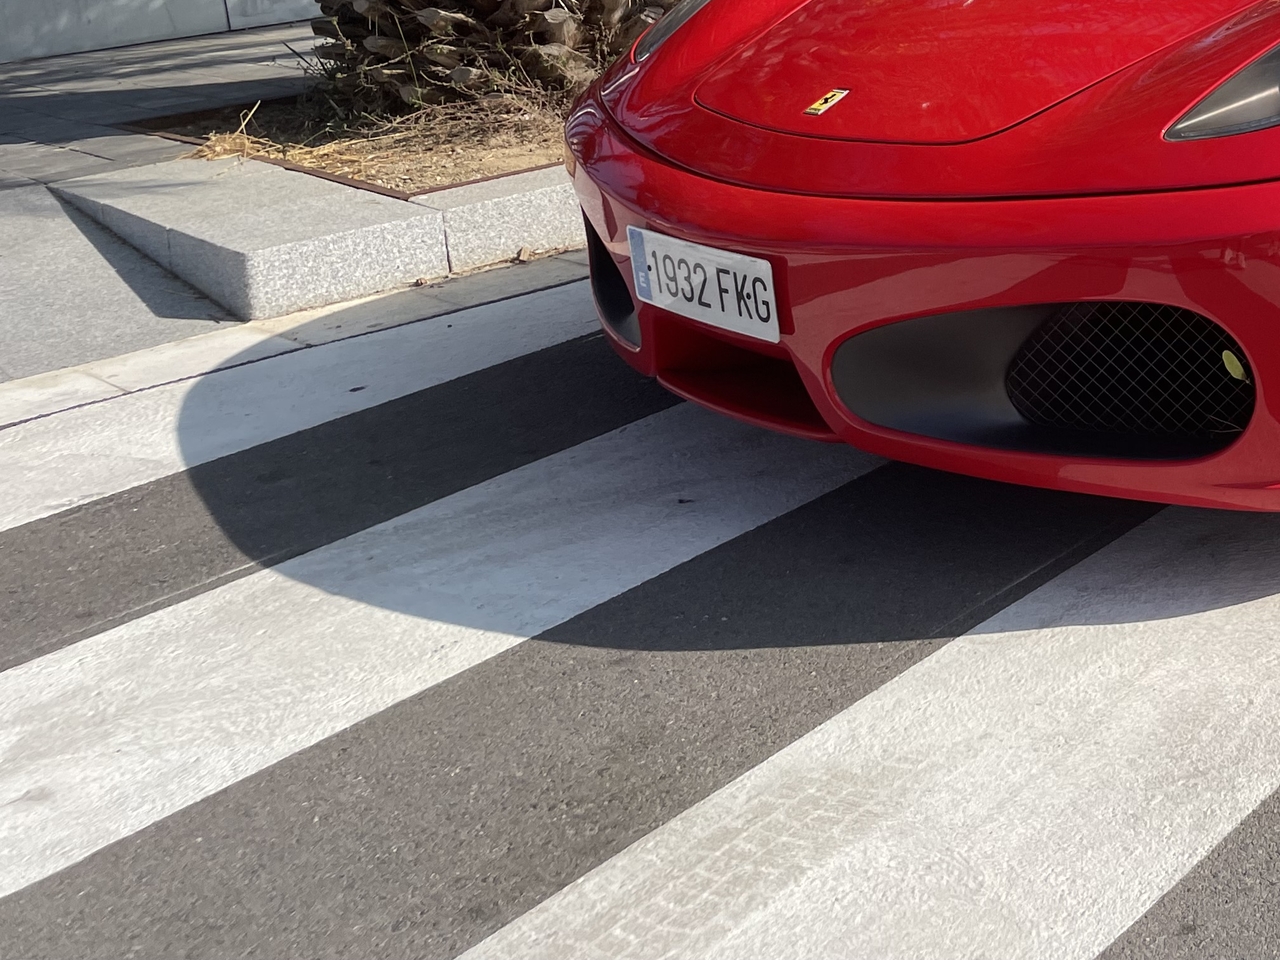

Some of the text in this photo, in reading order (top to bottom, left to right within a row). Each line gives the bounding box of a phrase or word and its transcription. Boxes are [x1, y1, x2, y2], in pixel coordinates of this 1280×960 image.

[638, 272, 647, 287] E
[652, 250, 771, 323] 1932 FKG
